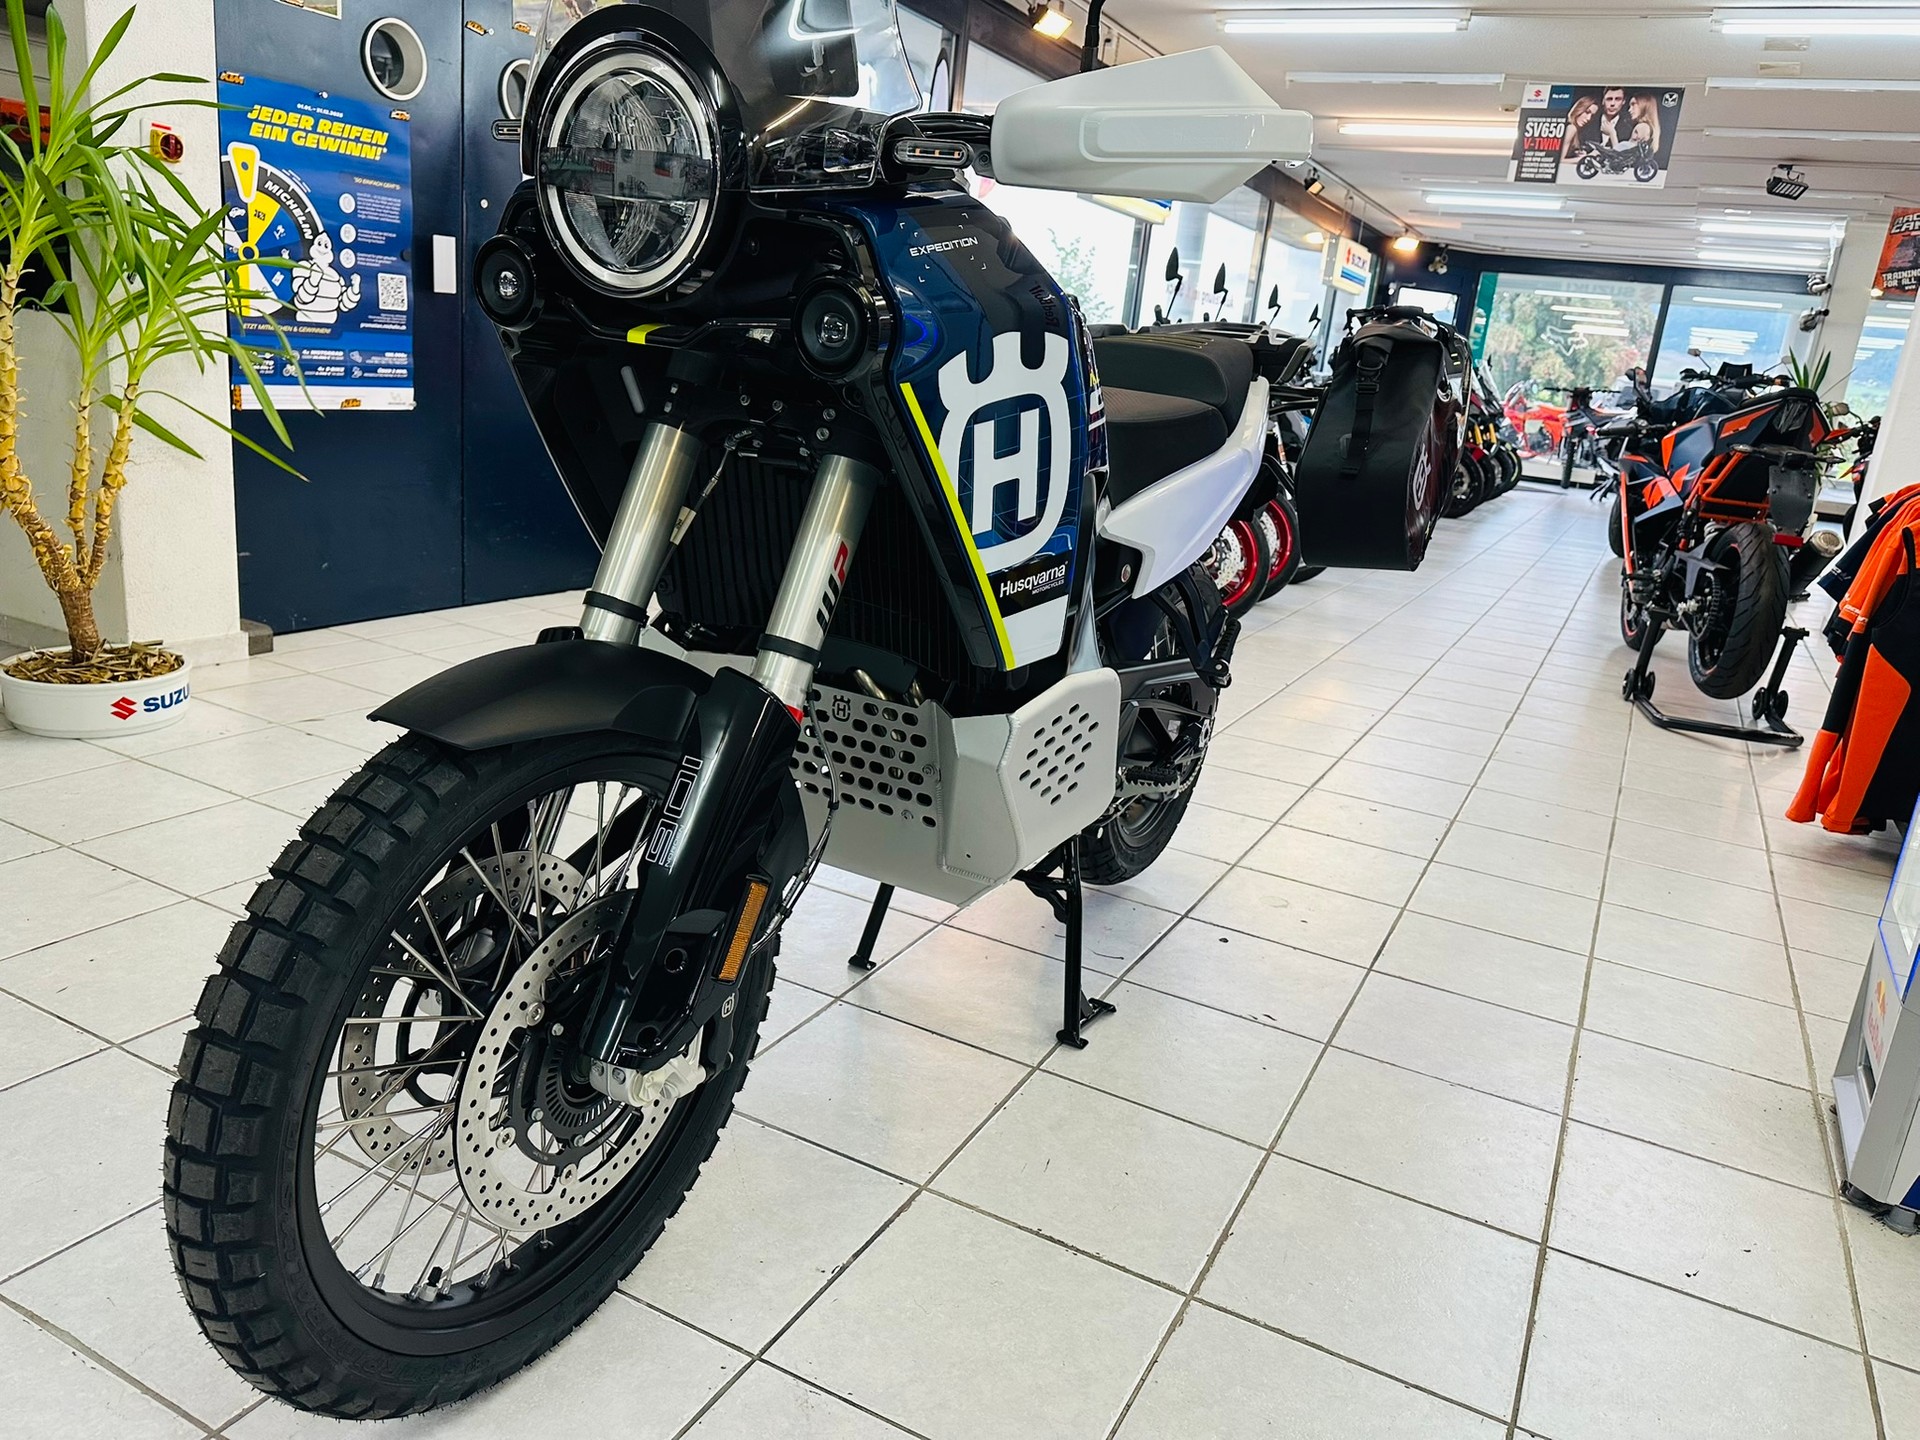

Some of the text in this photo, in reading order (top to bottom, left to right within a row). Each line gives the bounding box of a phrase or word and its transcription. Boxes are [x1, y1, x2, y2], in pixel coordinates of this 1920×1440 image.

[247, 104, 389, 146] JEDER REIFEN
[249, 121, 289, 143] EIN
[1524, 121, 1565, 138] SV650
[1523, 137, 1561, 151] V-TWIN
[264, 180, 314, 240] MICHELIN
[909, 236, 979, 257] EXPEDITION
[1883, 277, 1917, 288] FOR ALL
[1000, 563, 1066, 598] Husqvarna
[1031, 578, 1065, 596] MOTORCYCLES
[645, 755, 704, 867] 901
[664, 824, 685, 868] NORDEN
